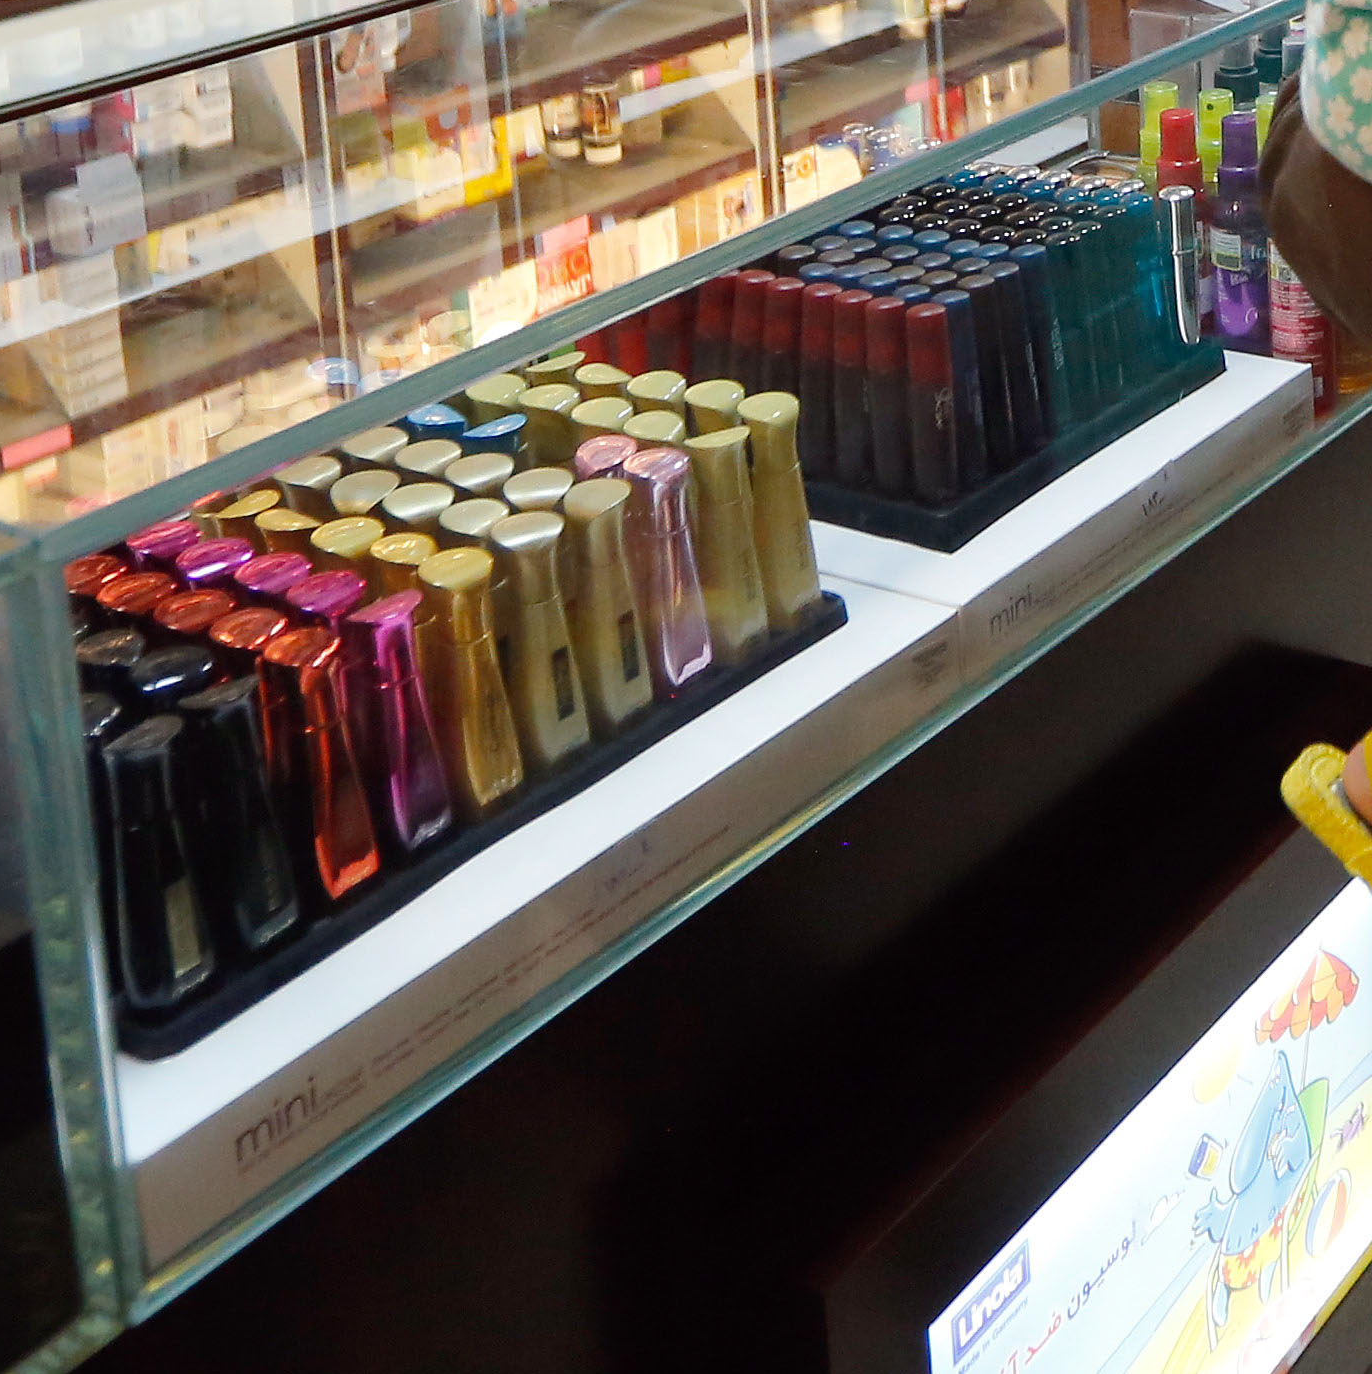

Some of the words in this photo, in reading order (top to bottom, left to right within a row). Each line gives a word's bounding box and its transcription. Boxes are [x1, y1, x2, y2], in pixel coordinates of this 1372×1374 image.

[989, 583, 1033, 636] mini
[234, 1076, 318, 1162] mini
[959, 1253, 1024, 1348] Linola
[982, 1339, 990, 1352] in
[992, 1296, 1029, 1340] Germany
